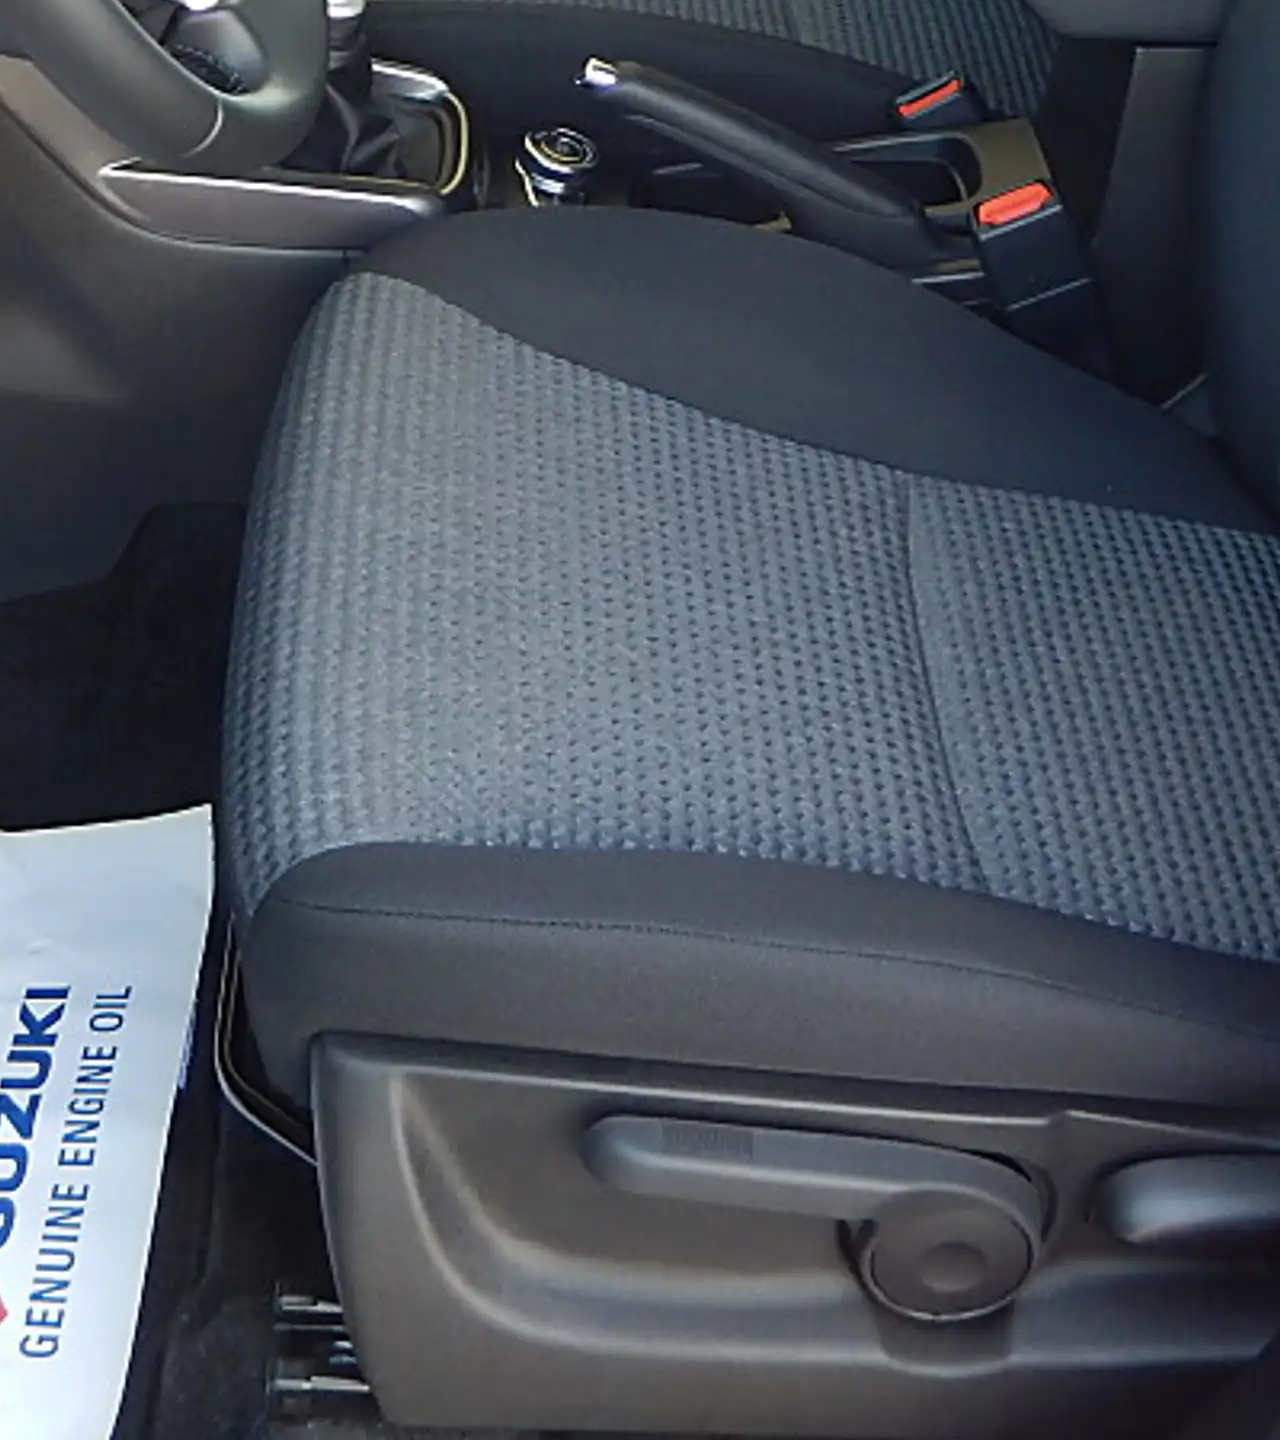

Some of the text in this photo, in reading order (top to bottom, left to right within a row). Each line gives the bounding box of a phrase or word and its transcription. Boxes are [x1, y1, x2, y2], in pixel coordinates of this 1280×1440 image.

[19, 984, 132, 1358] GENUINE ENGINE OIL
